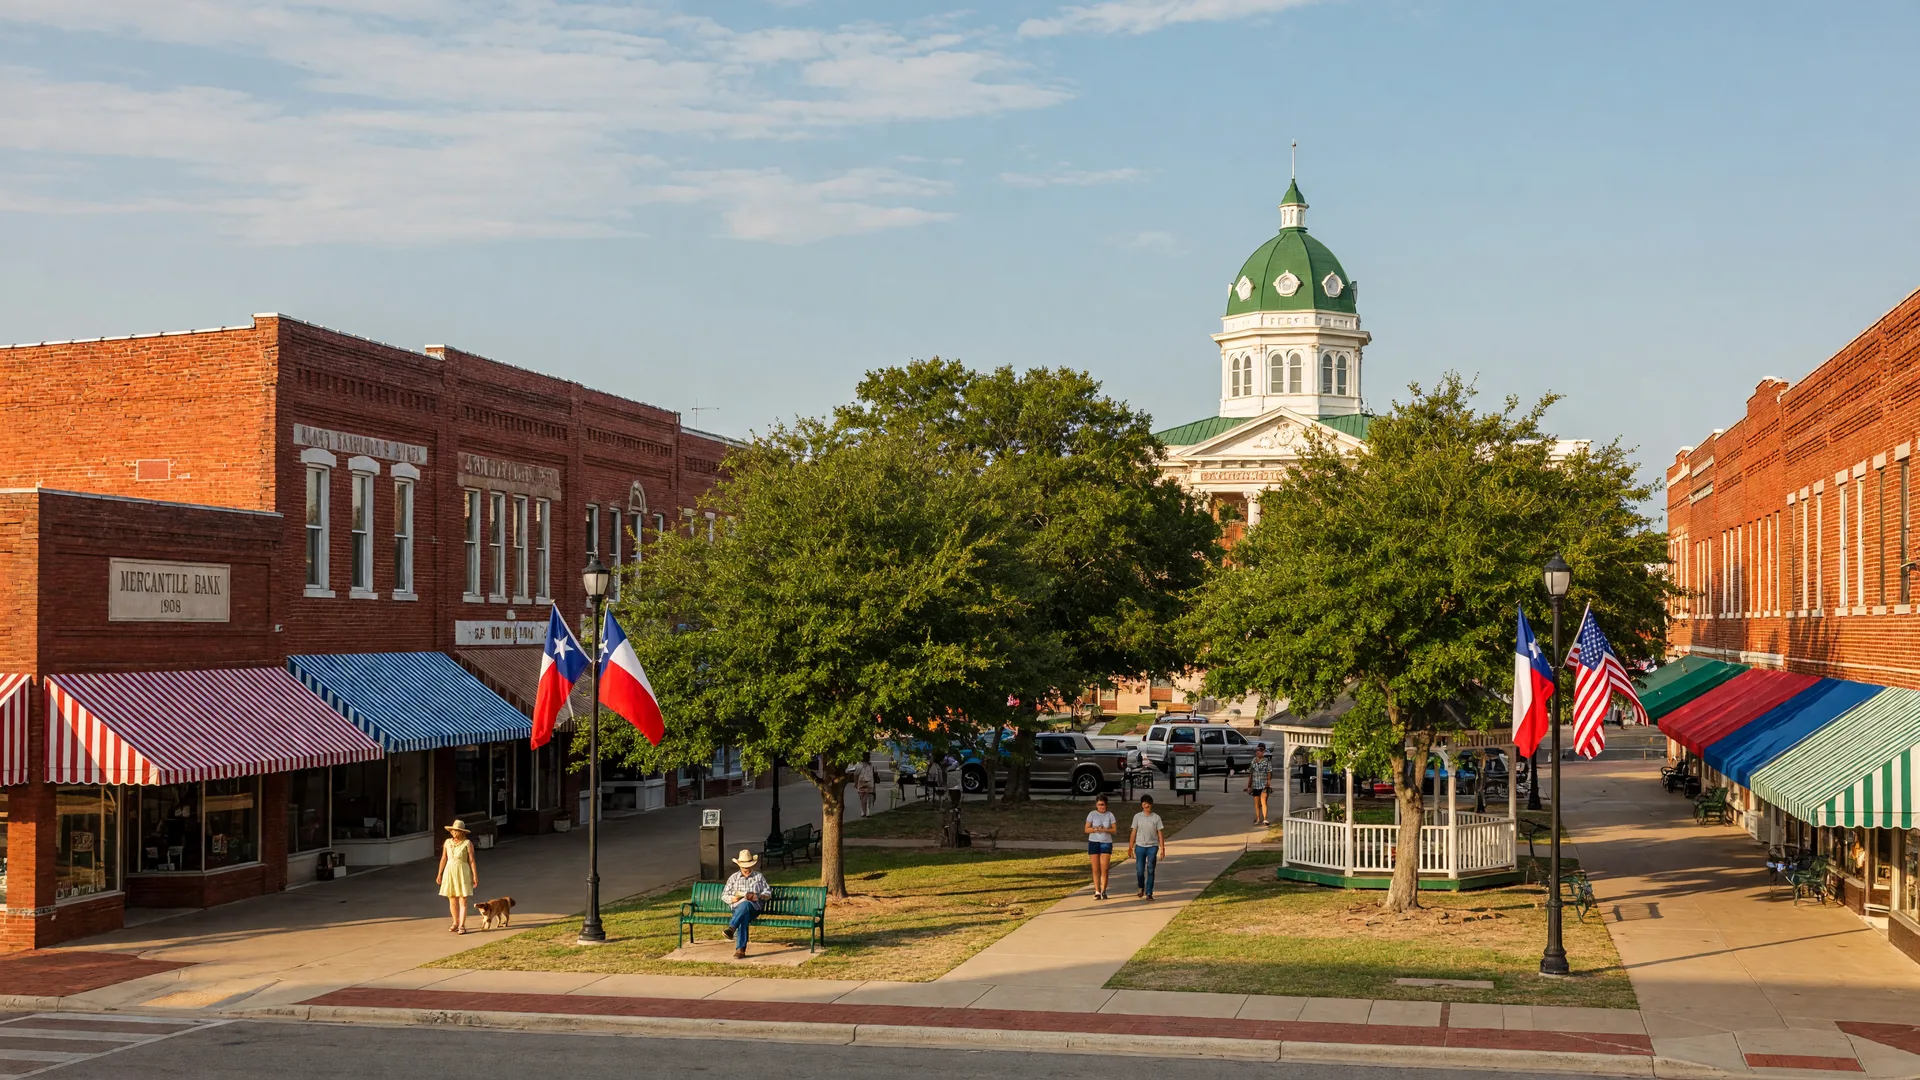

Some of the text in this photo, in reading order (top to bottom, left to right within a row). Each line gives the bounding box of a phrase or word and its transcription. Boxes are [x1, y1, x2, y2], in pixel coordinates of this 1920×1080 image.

[120, 570, 221, 595] MERCANTILE BANK
[160, 599, 181, 613] 1908
